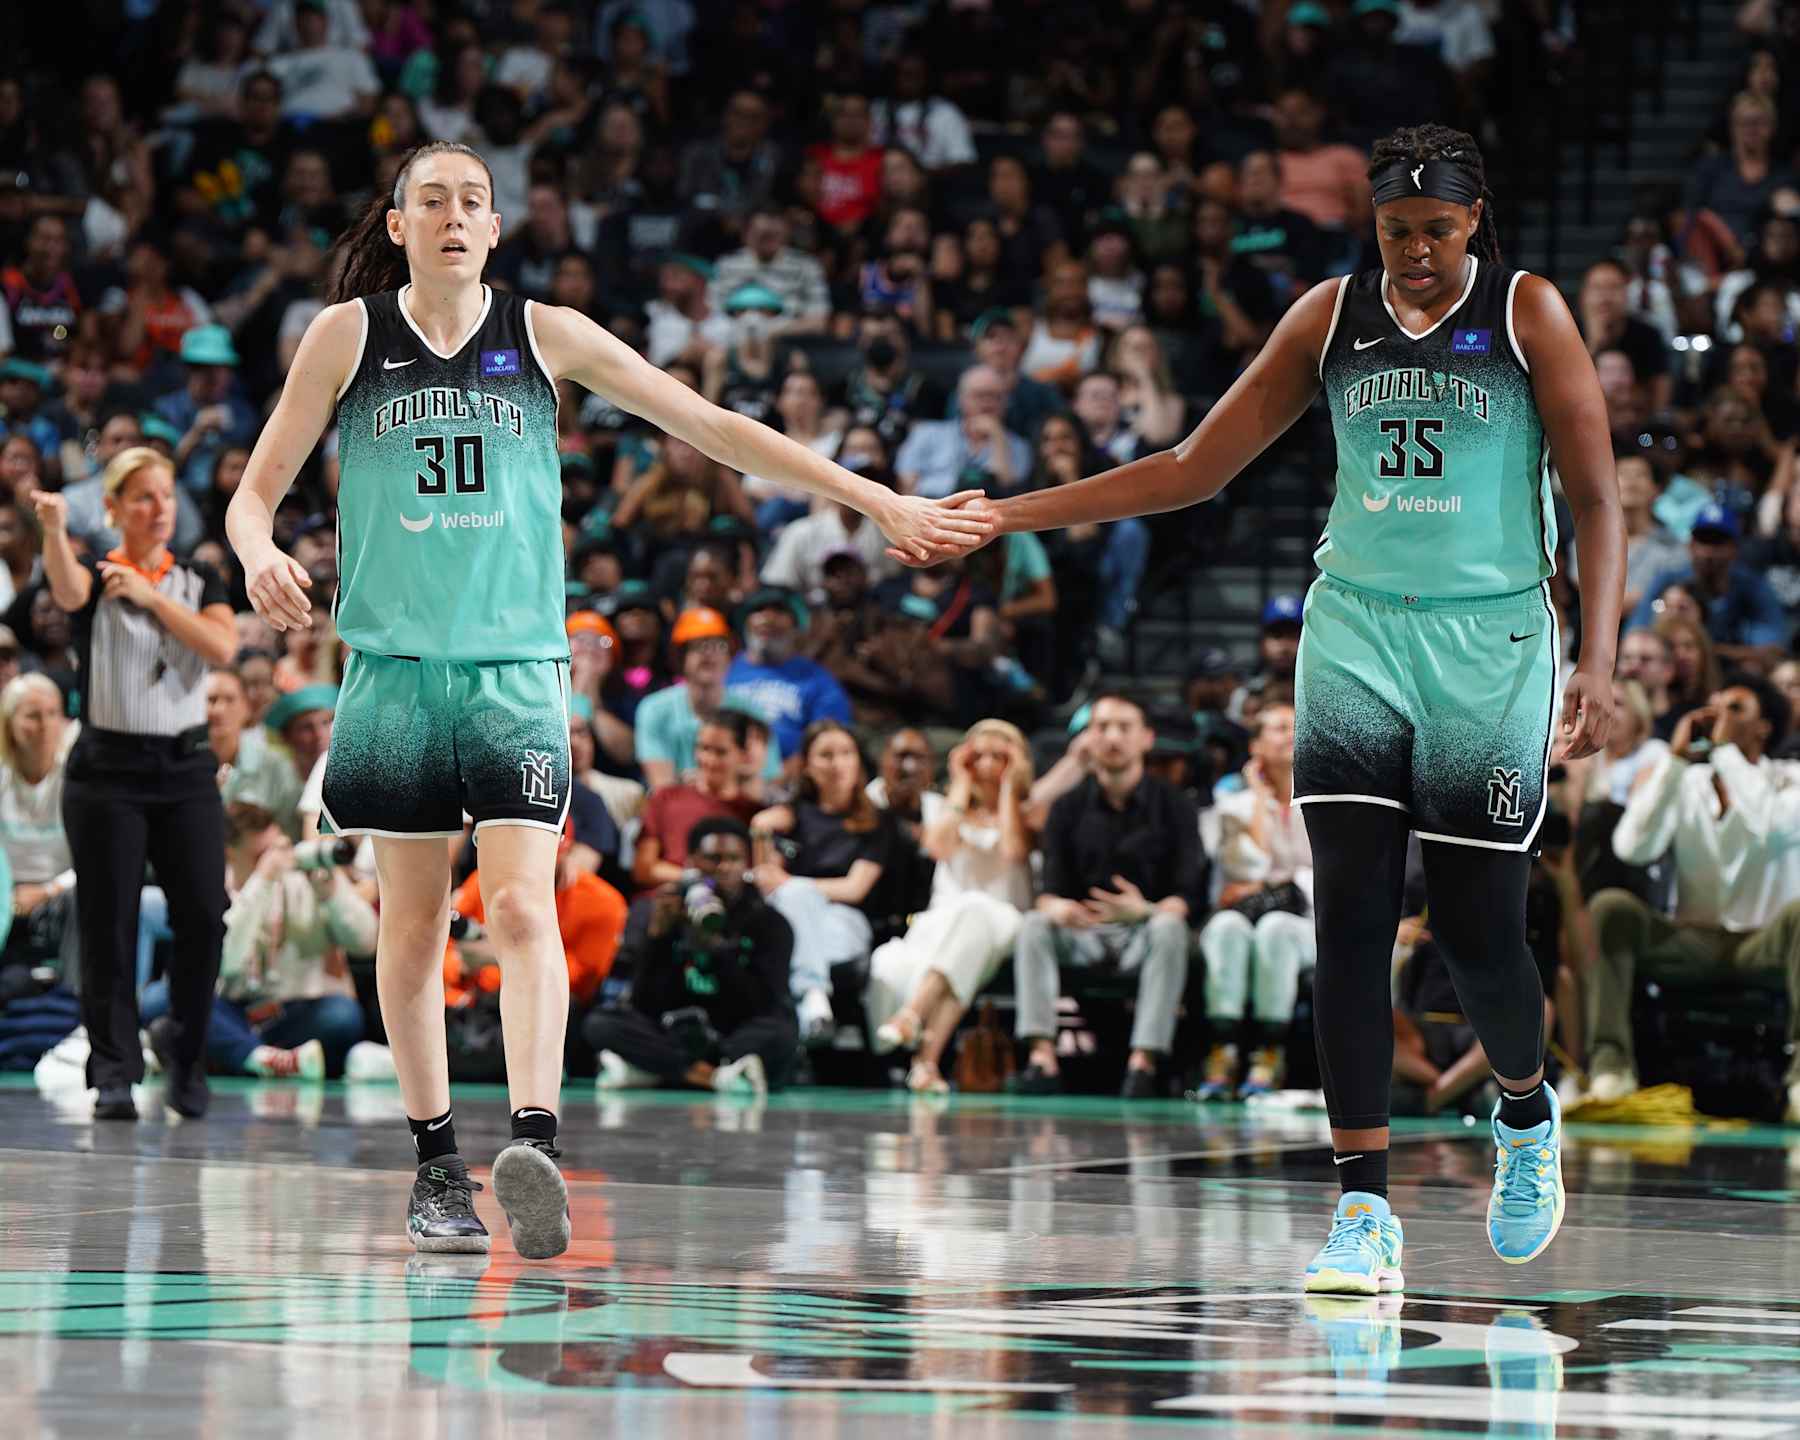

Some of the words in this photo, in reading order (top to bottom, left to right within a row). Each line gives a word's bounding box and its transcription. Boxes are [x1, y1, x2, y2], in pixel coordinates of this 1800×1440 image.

[1455, 343, 1486, 351] BARCLAYS
[1378, 418, 1445, 479] 35
[414, 433, 487, 496] 30
[1396, 495, 1462, 513] Webull
[440, 510, 505, 529] Webull
